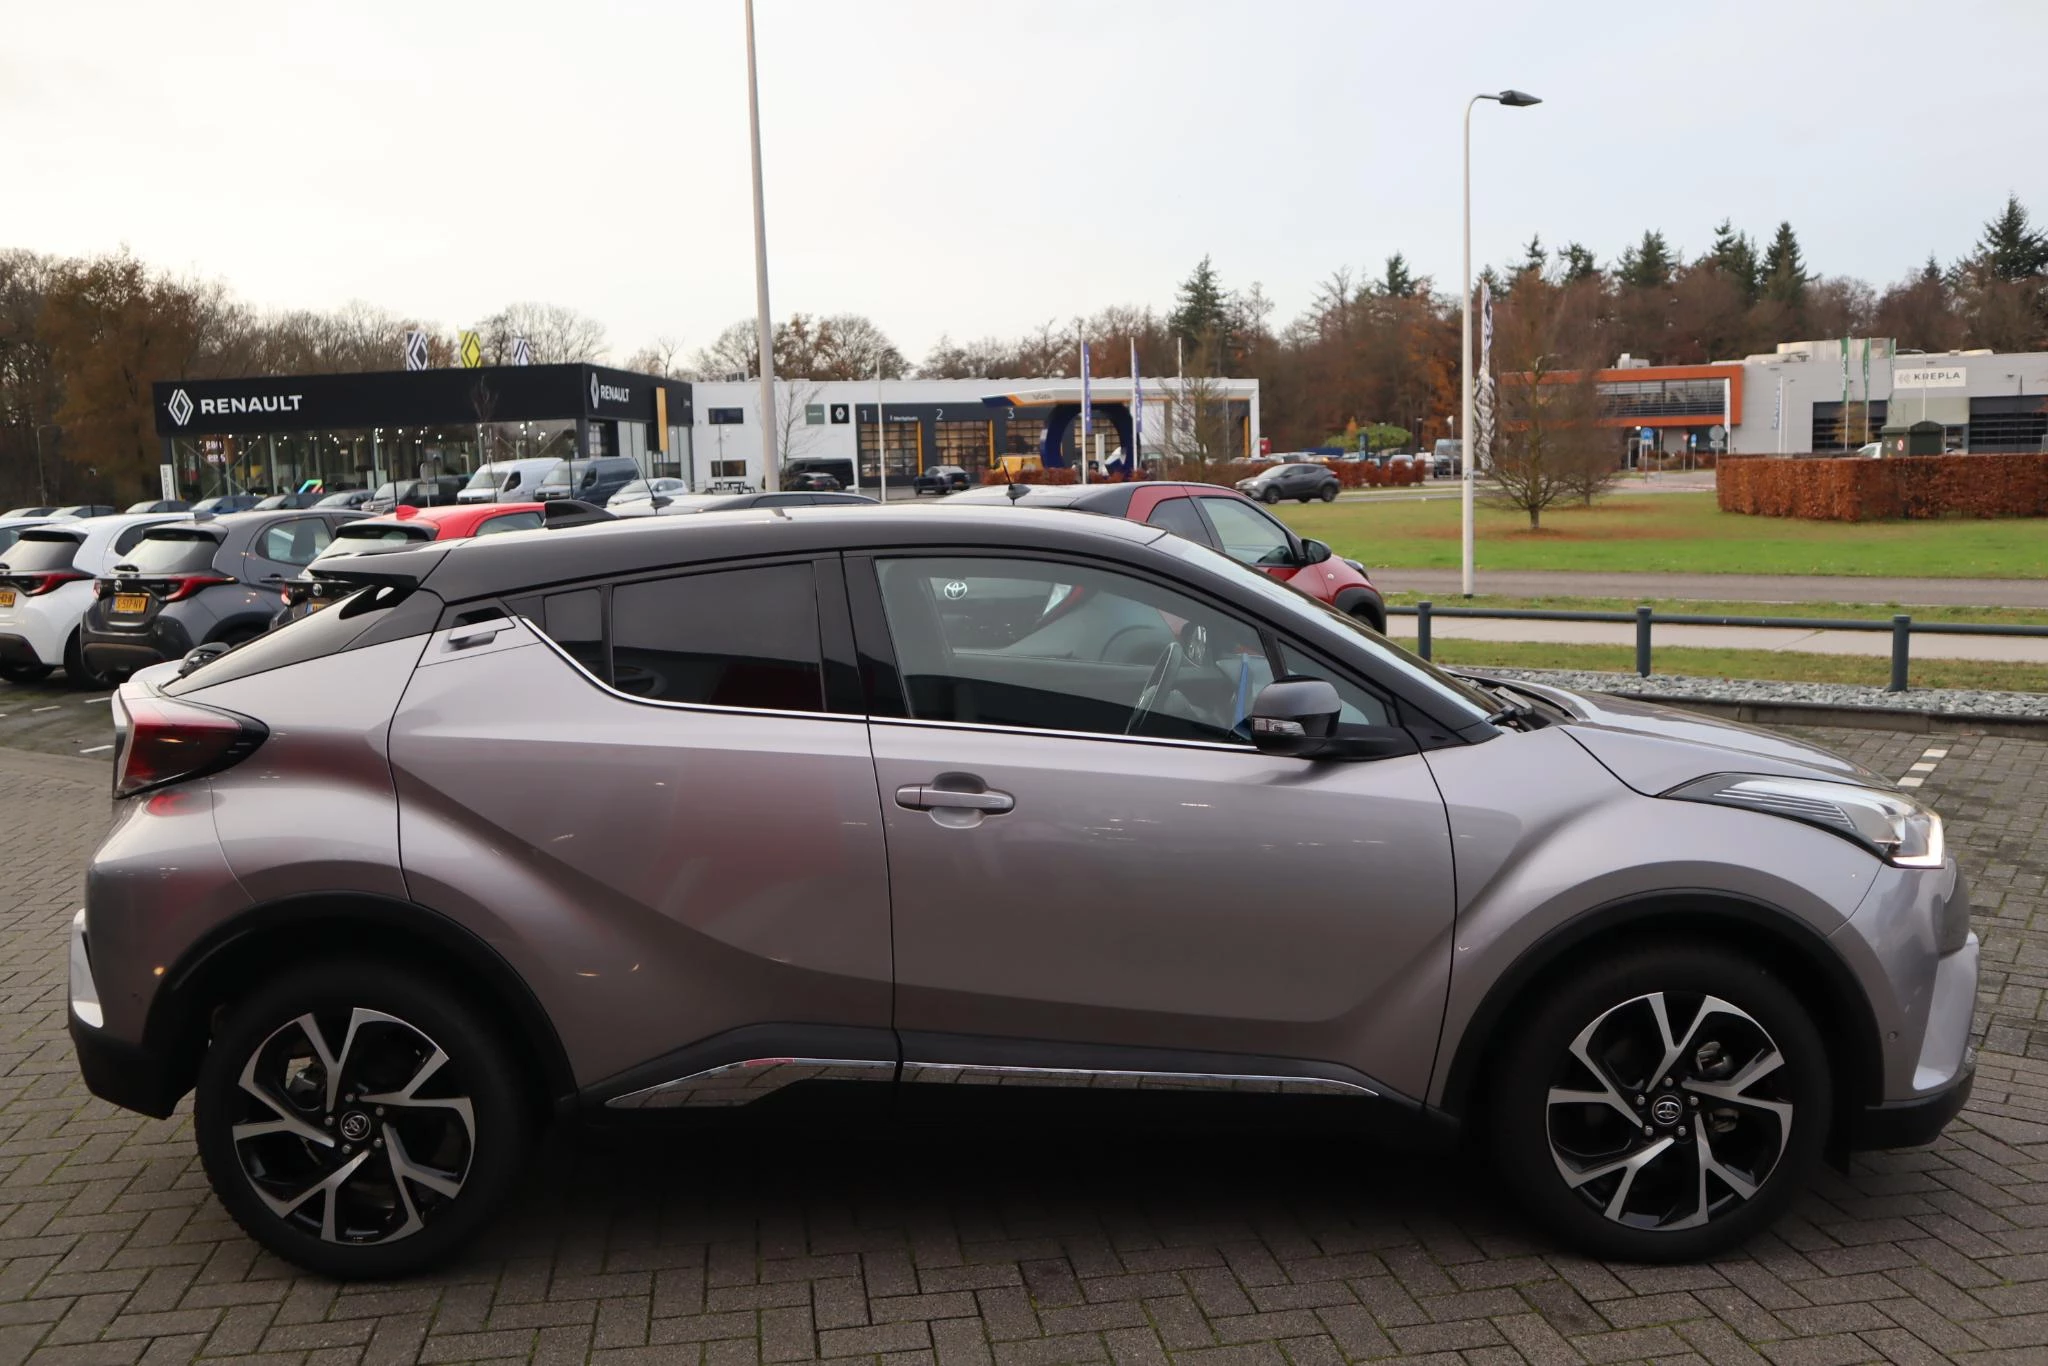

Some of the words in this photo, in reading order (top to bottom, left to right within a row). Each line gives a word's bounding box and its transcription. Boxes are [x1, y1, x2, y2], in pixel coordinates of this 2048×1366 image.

[1914, 371, 1960, 380] KREPLA
[600, 385, 630, 402] RENAULT
[200, 395, 302, 414] RENAULT
[861, 409, 867, 421] 1
[936, 408, 943, 420] 2
[1007, 407, 1015, 419] 3
